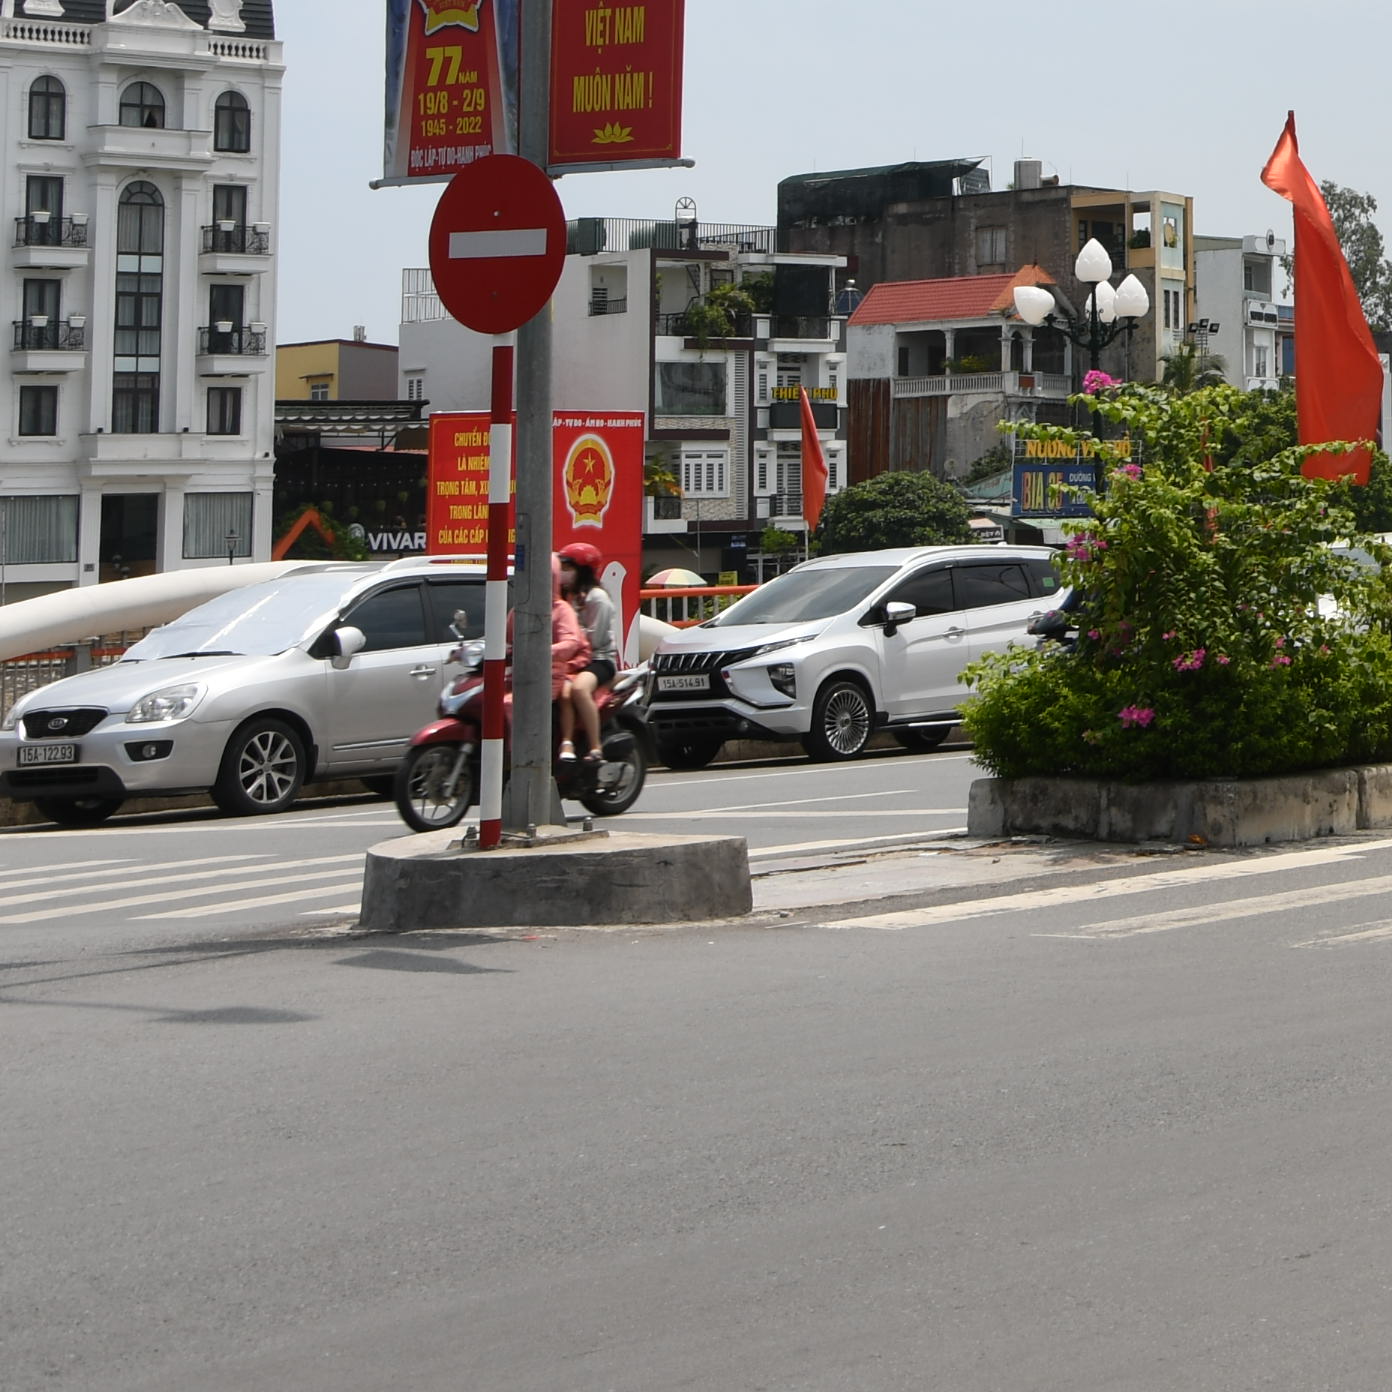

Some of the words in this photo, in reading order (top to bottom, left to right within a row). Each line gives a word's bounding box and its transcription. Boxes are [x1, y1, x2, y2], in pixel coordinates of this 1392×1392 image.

[585, 0, 612, 54] VIỆT
[615, 6, 645, 44] NAM
[426, 46, 462, 86] 77
[418, 92, 448, 115] 19/8
[463, 88, 485, 112] 2/9
[573, 67, 611, 113] MUÔN
[615, 65, 644, 110] NĂM
[421, 119, 446, 137] 1945
[456, 116, 482, 135] 2022
